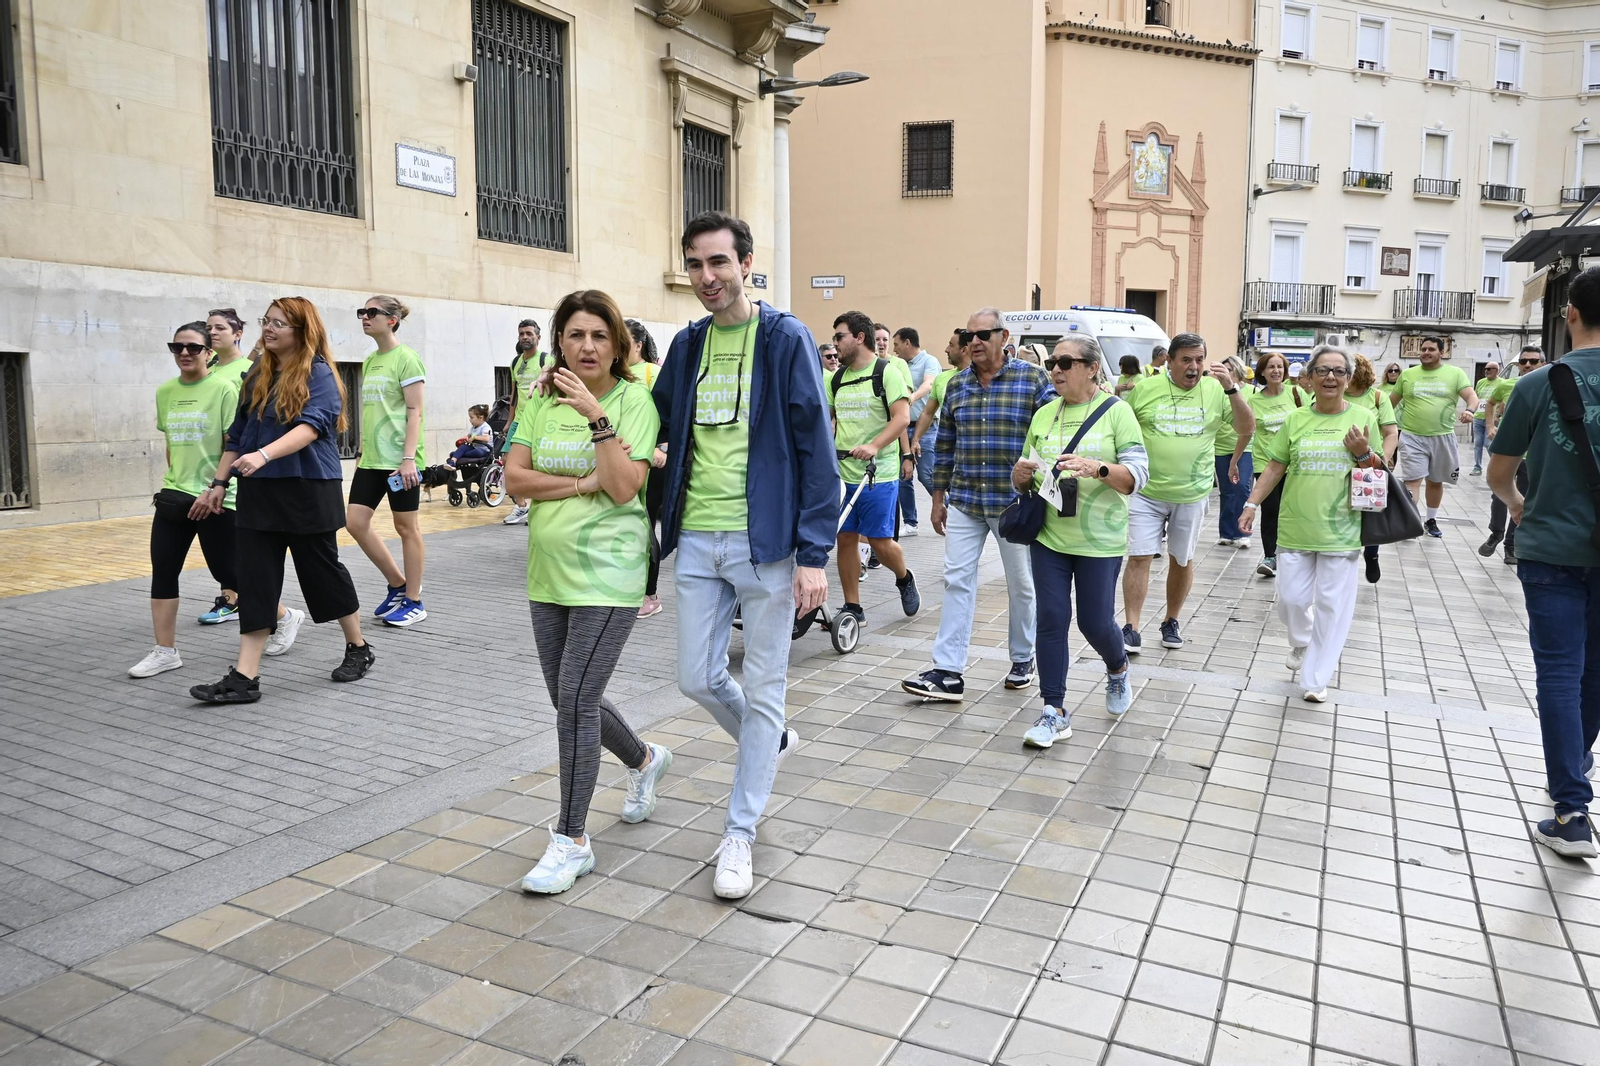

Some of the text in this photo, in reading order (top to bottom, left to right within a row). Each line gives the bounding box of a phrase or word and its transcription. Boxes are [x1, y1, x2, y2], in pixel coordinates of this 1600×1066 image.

[413, 155, 430, 168] PLAZA
[400, 167, 407, 177] DE
[408, 168, 420, 179] LAS
[1003, 313, 1069, 322] ECCION CIVIL
[714, 370, 752, 385] march
[835, 399, 869, 408] contra el
[695, 404, 750, 423] cáne
[836, 407, 871, 419] cáncer
[166, 420, 205, 430] contra el
[540, 437, 596, 451] En marc
[1087, 440, 1102, 452] el
[1300, 438, 1312, 447] En
[1299, 449, 1339, 458] contra
[537, 454, 589, 469] contra
[1300, 458, 1351, 472] cáncer
